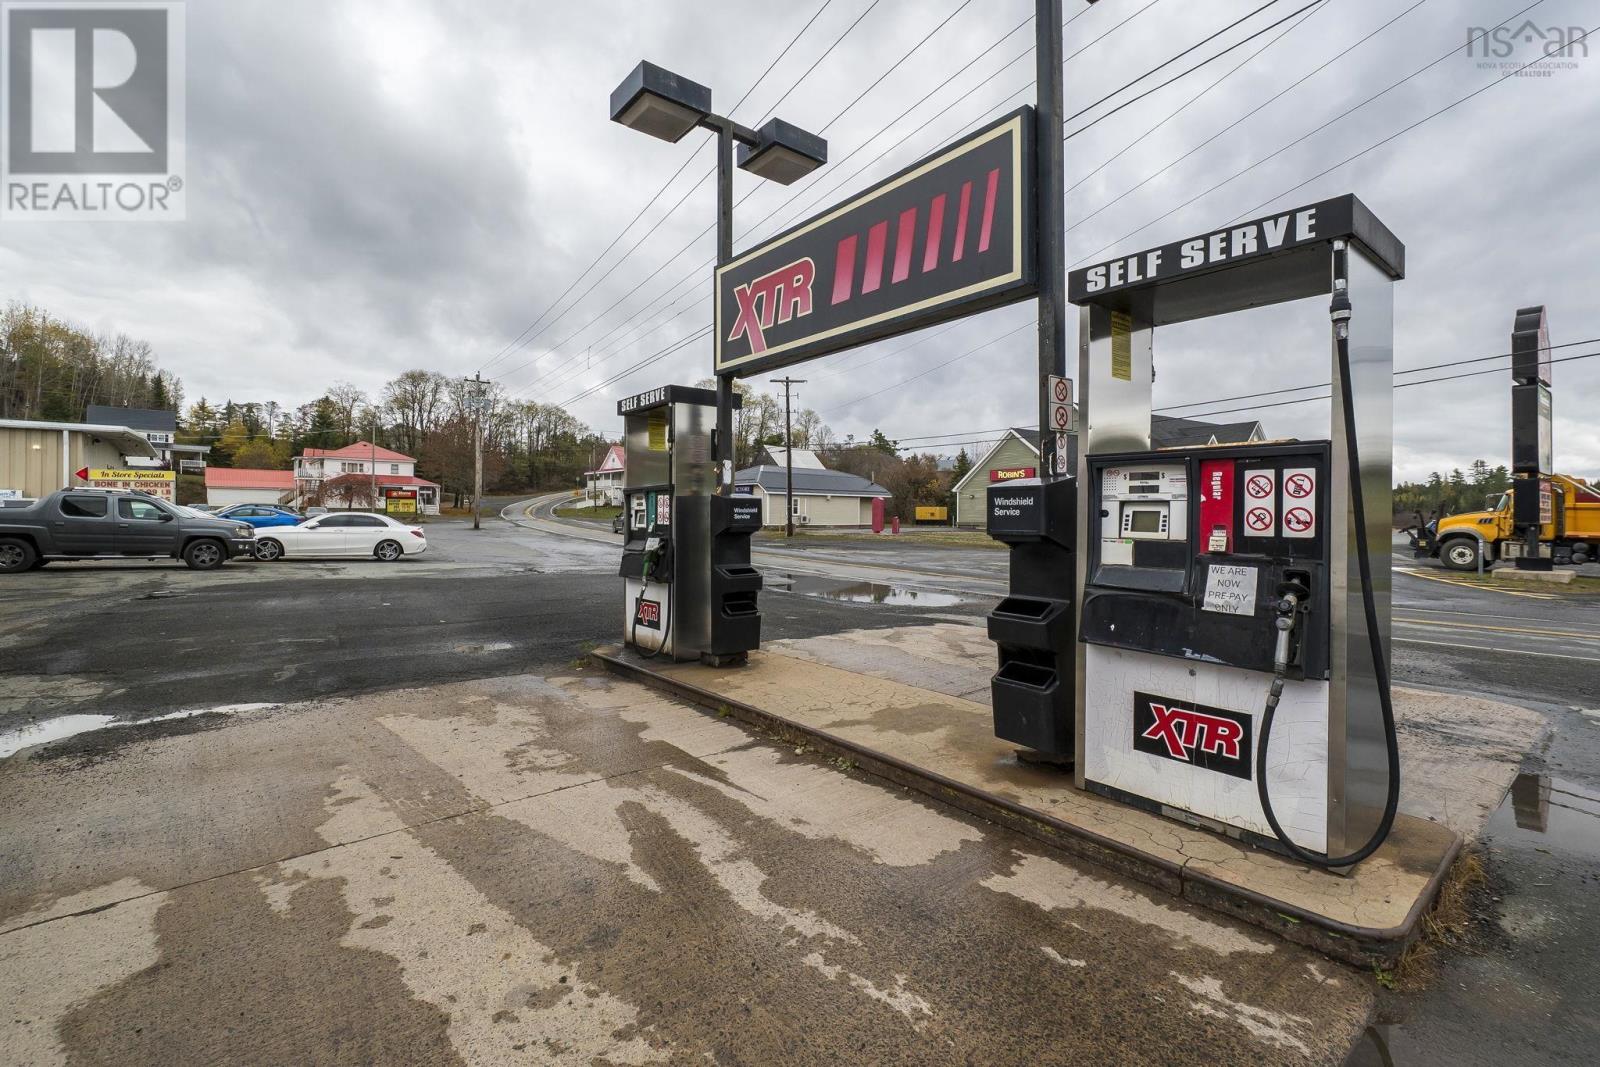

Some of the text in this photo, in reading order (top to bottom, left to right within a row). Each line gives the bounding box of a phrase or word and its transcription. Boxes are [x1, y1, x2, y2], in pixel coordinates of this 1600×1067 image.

[1086, 208, 1316, 293] SELF SERVE
[727, 256, 816, 355] XTR
[621, 387, 665, 412] SELF SERVE
[133, 471, 165, 479] Specials
[1211, 471, 1223, 500] Regular
[994, 496, 1034, 506] Windshield
[994, 507, 1020, 516] Service
[1211, 566, 1247, 576] WE ARE
[1217, 579, 1240, 588] NOW
[1208, 591, 1248, 602] PRE-PAY
[638, 601, 659, 626] XTR
[1214, 603, 1239, 613] ONLY
[1141, 702, 1243, 761] XTR
